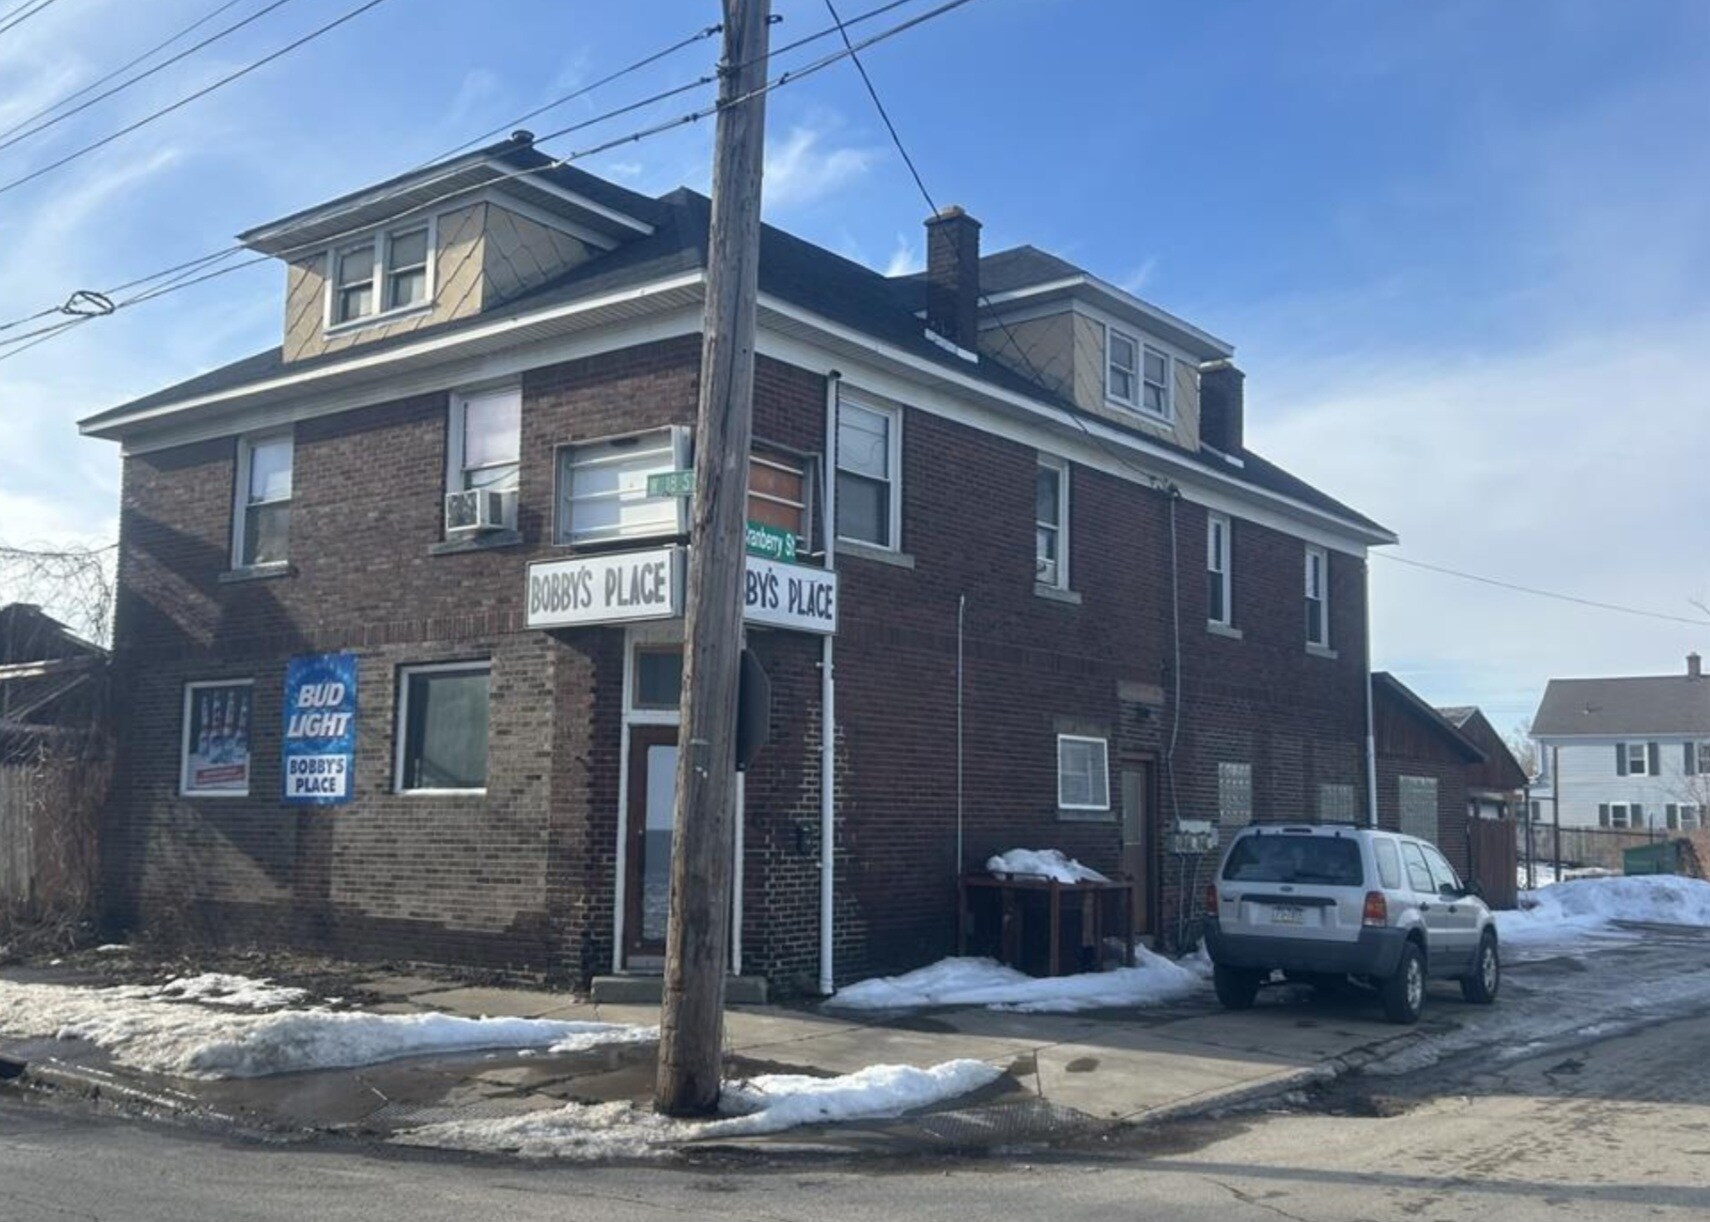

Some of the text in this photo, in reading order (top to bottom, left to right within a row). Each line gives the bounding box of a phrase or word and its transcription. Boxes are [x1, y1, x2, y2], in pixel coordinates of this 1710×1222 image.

[682, 473, 694, 490] S
[746, 523, 795, 557] ranberry St
[530, 561, 666, 614] BOBBY'S PLACE
[746, 567, 833, 620] BY'S PLACE
[298, 683, 345, 708] BUD
[287, 712, 353, 738] LIGHT
[290, 757, 344, 775] BOBBY'S
[296, 776, 336, 793] PLACE
